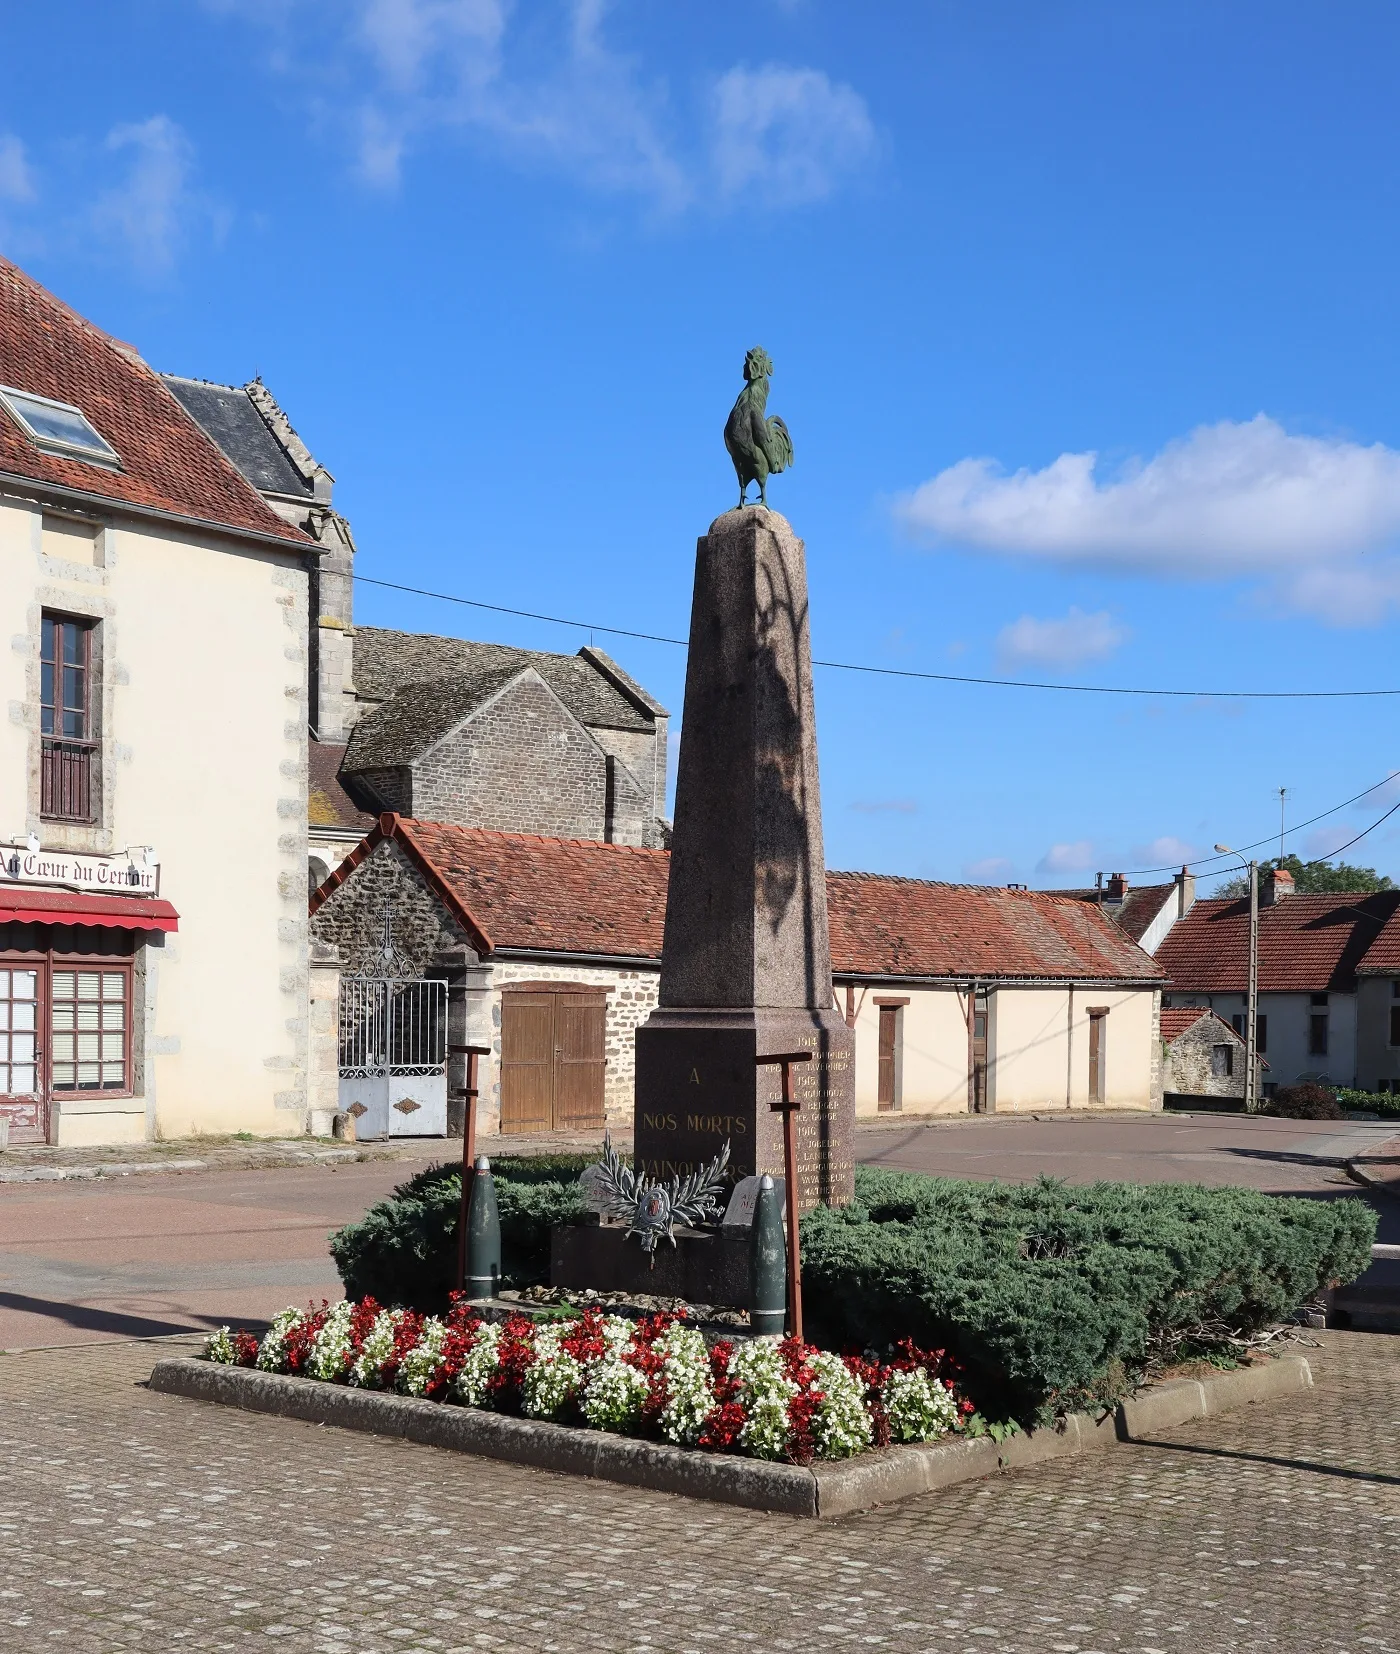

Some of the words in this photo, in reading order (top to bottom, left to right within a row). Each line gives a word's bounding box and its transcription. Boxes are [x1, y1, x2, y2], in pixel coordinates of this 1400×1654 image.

[73, 861, 93, 882] du
[97, 862, 153, 888] Terroir
[798, 1037, 818, 1047] 1914
[689, 1067, 700, 1085] A
[797, 1076, 816, 1086] 1915
[643, 1112, 677, 1131] NOS
[687, 1114, 747, 1136] MORTS
